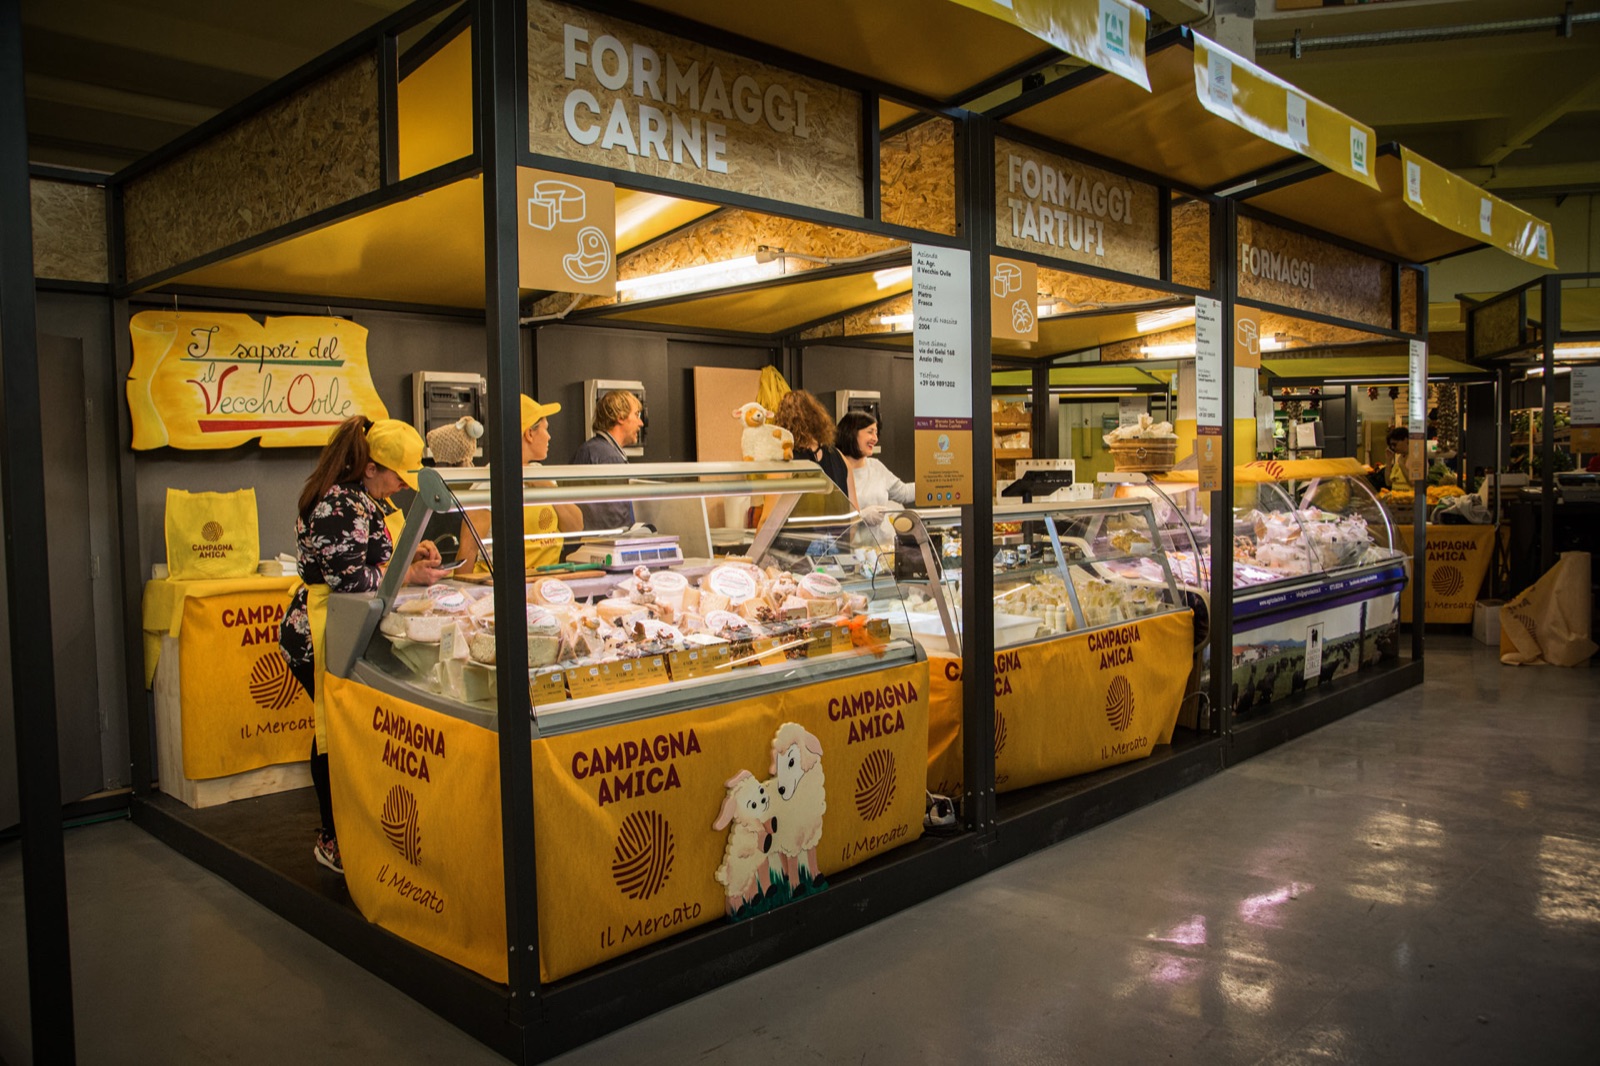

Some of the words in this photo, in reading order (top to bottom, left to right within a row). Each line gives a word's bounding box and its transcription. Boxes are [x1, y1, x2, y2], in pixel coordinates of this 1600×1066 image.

[564, 23, 812, 139] FORMAGGI
[563, 88, 728, 174] CARNE
[1009, 154, 1132, 225] FORMAGGI
[1008, 198, 1104, 257] TARTUFI
[921, 268, 939, 276] Vecchio
[940, 270, 951, 278] Ovile
[1241, 243, 1315, 290] FORMAGGI
[918, 291, 932, 299] Pietro
[918, 299, 933, 307] Frasca
[230, 339, 299, 373] sapori
[309, 336, 340, 360] del
[919, 355, 932, 363] Anzio
[192, 543, 233, 552] CAMPAGNA
[199, 551, 226, 559] AMICA
[1426, 540, 1477, 551] AMPAGNA
[1428, 552, 1467, 561] AMICA
[222, 603, 285, 628] CAMPA
[241, 625, 280, 647] AMI
[1087, 625, 1140, 652] CAMPAGNA
[1100, 646, 1134, 671] AMICA
[827, 681, 918, 722] CAMPAGNA
[256, 714, 316, 735] Mercat
[372, 706, 445, 758] CAMPAGNA
[847, 710, 905, 745] AMICA
[382, 739, 430, 783] AMICA
[571, 728, 702, 780] CAMPAGNA
[1111, 736, 1148, 758] Mercato
[598, 763, 682, 807] AMICA
[853, 823, 909, 854] Mercato
[387, 871, 444, 914] Mercato
[621, 902, 702, 942] Mercato
